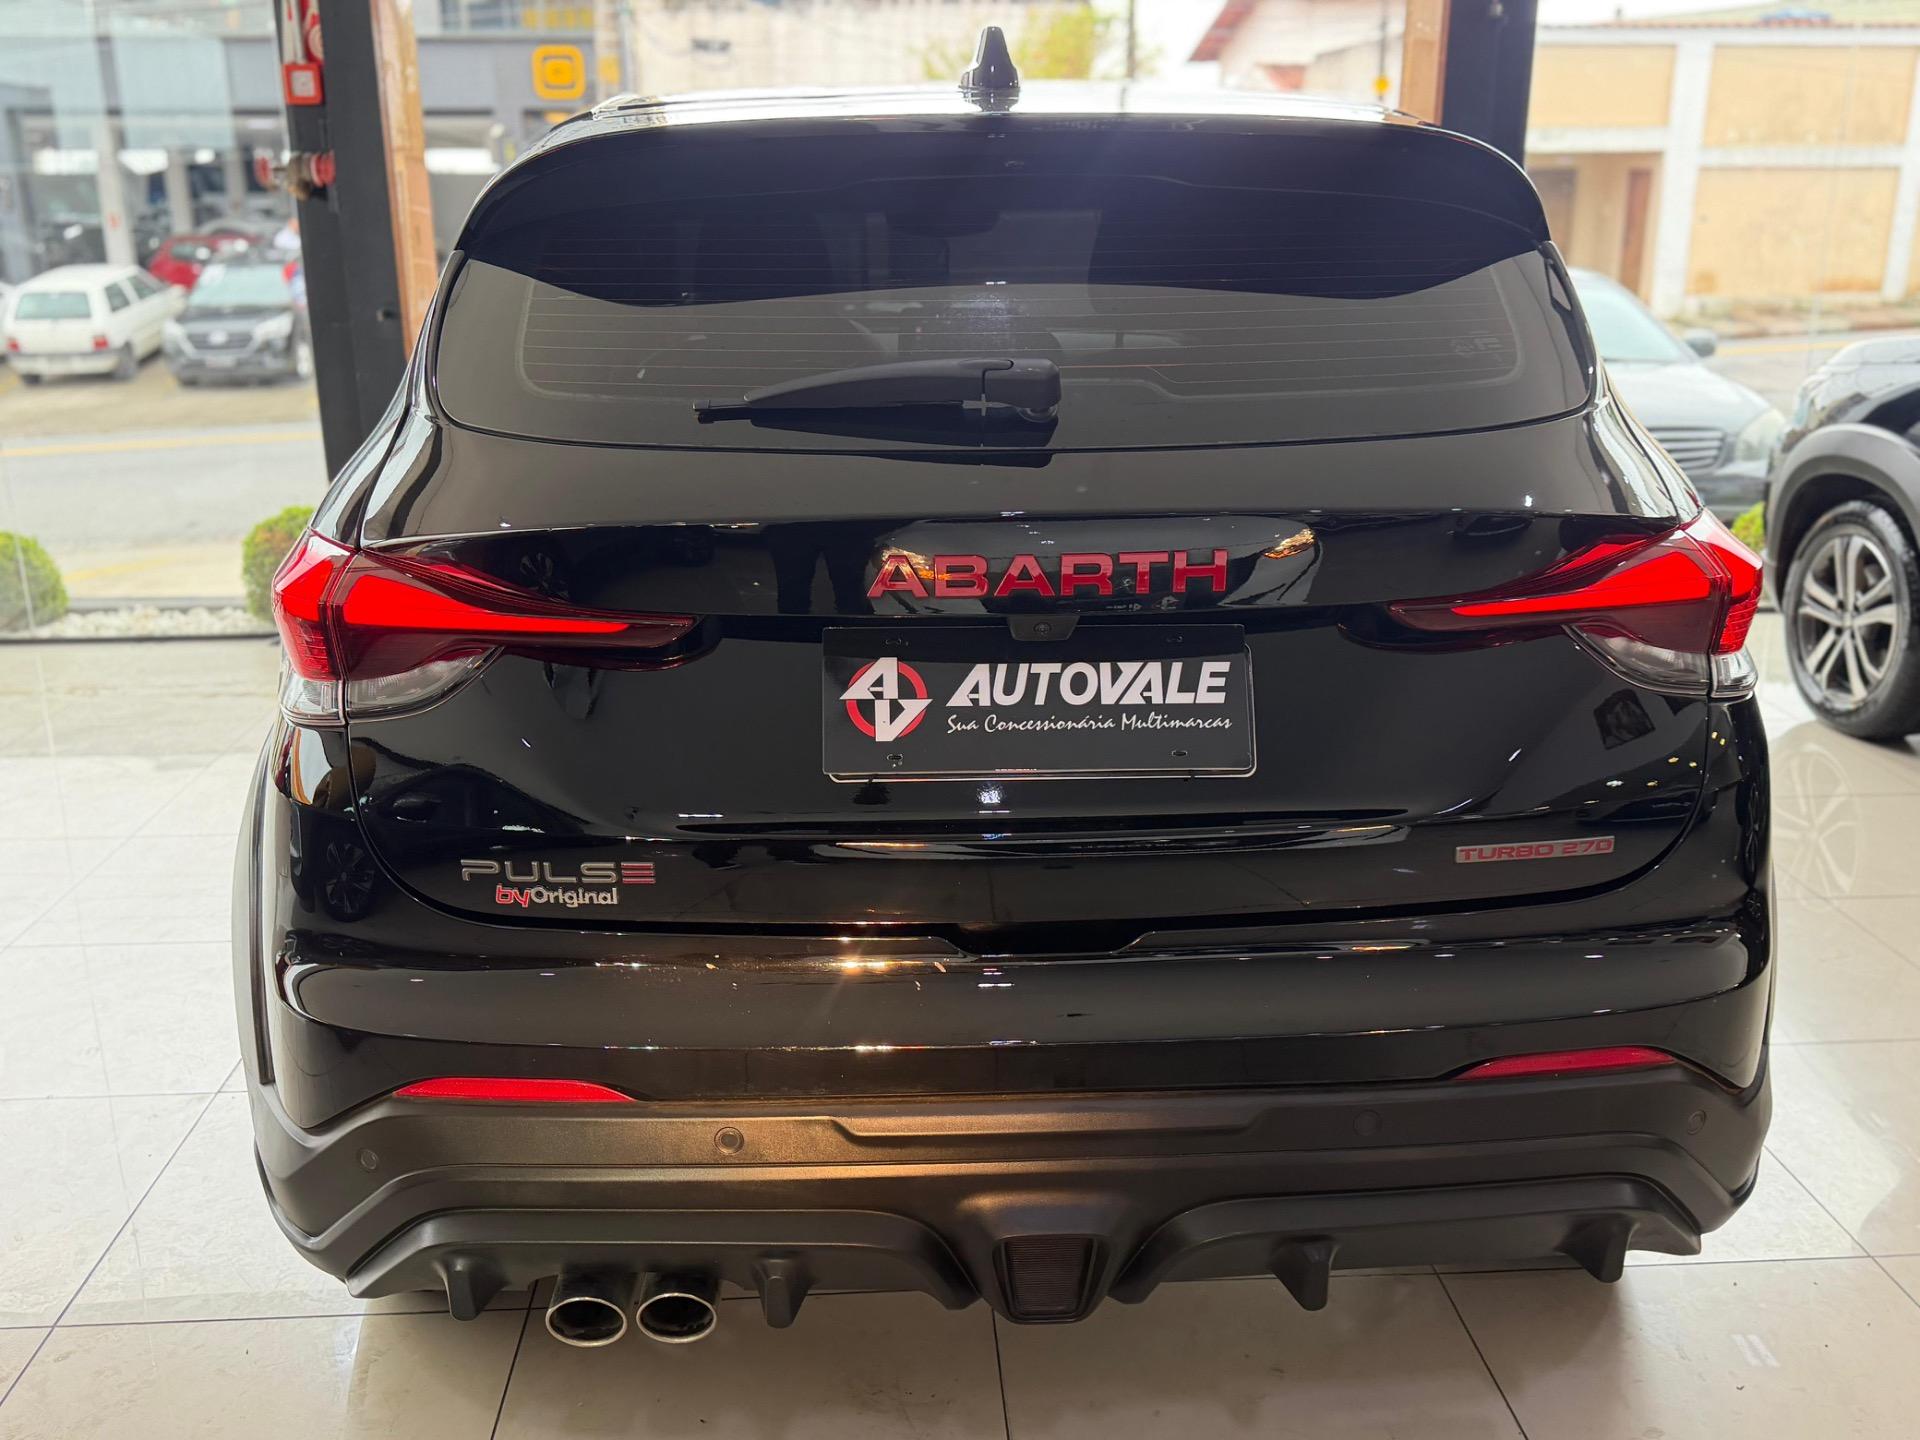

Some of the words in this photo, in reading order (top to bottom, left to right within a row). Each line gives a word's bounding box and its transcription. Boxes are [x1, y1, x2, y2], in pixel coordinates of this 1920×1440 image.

[867, 549, 1229, 598] ABARTH
[945, 661, 1231, 707] AUTOVALE
[947, 714, 979, 734] Sua
[984, 713, 1116, 732] Concessionária
[1121, 711, 1232, 731] Multimarcas
[1460, 843, 1554, 861] TURBO
[1562, 838, 1614, 855] 270
[460, 859, 656, 884] PULSE
